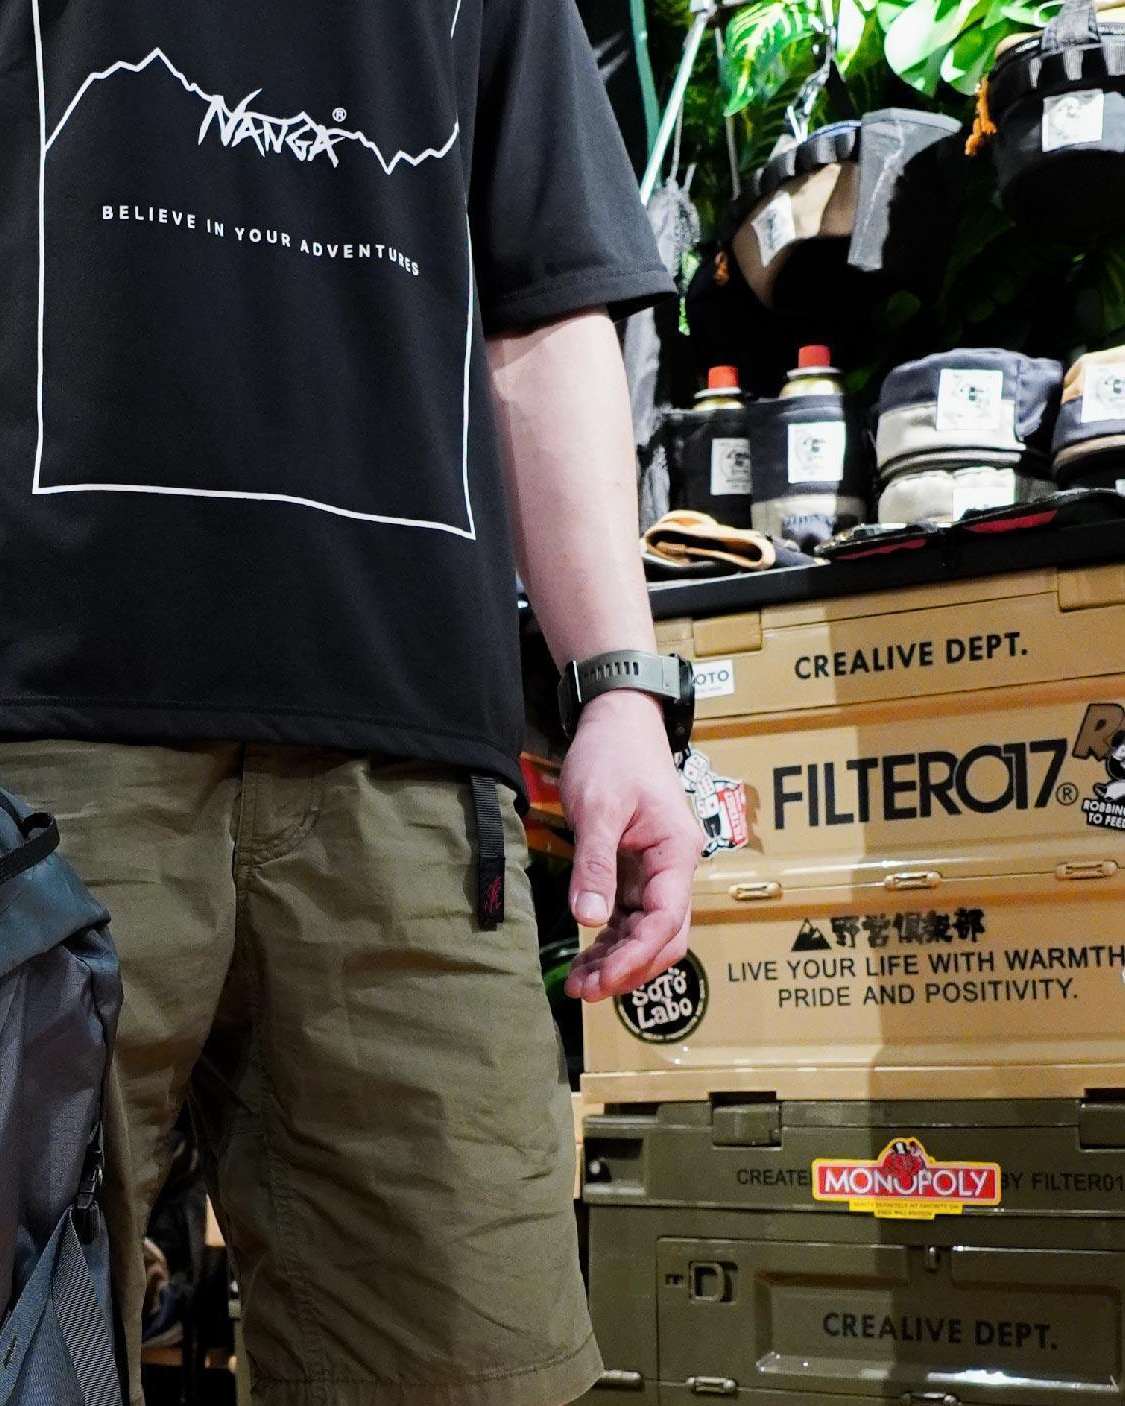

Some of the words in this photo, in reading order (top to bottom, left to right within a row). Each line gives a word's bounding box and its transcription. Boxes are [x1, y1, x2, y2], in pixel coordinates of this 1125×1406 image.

[101, 204, 196, 229] BELIEVE
[206, 218, 225, 238] IN
[234, 226, 291, 248] YOUR
[300, 239, 420, 277] ADVENTURES
[793, 640, 934, 680] CREALIVE
[945, 631, 1029, 665] DEPT.
[693, 669, 730, 687] OTO
[1082, 798, 1125, 817] ROBBIN
[1088, 812, 1103, 825] TO
[1104, 814, 1125, 829] FEE
[727, 961, 778, 983] LIVE
[786, 957, 856, 979] YOUR
[865, 954, 920, 978] LIFE
[927, 950, 995, 975] WITH
[1004, 944, 1125, 972] WARMTH
[778, 986, 852, 1009] PRIDE
[863, 982, 915, 1006] AND
[925, 976, 1078, 1004] POSITIVITY.
[736, 1168, 812, 1187] CREATE
[824, 1167, 988, 1198] MONOPOLY
[822, 1311, 963, 1344] CREALIVE
[974, 1319, 1058, 1350] DEPT.
